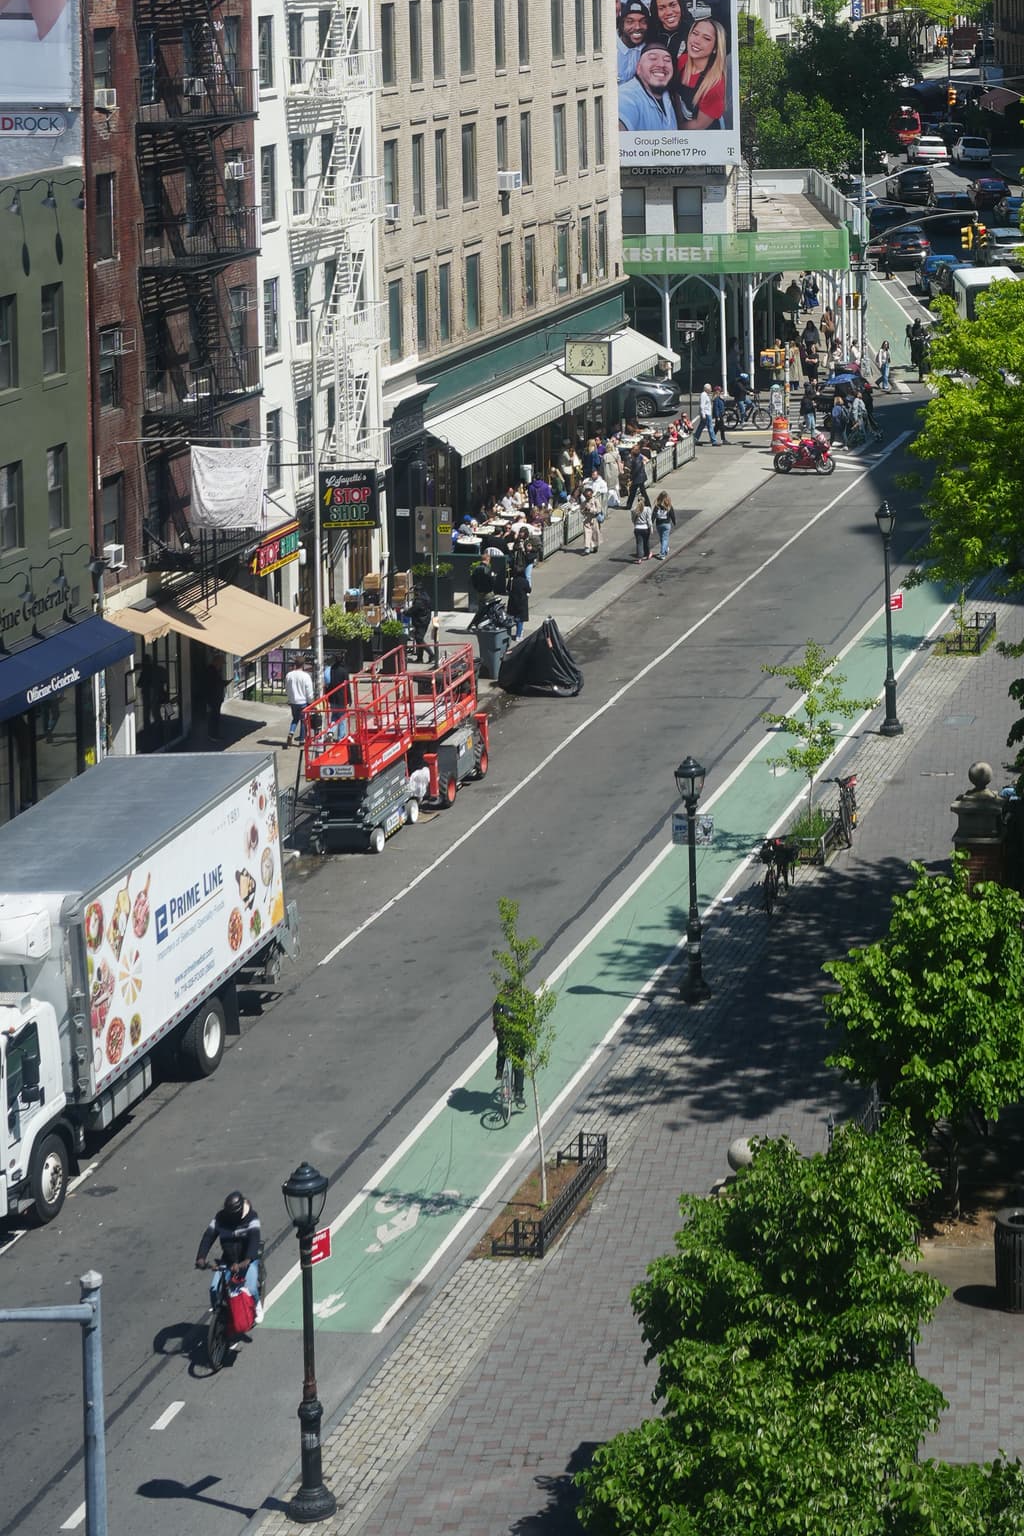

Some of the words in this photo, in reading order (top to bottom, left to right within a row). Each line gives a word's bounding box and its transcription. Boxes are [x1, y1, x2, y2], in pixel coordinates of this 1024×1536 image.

[634, 137, 660, 146] Group
[661, 136, 689, 145] Selfies
[651, 149, 681, 157] iPhone
[682, 148, 690, 156] 17
[692, 148, 707, 156] Pro
[641, 247, 713, 262] STREET
[323, 487, 333, 506] 1
[333, 487, 372, 505] STOP
[330, 504, 370, 522] SHOP
[257, 541, 280, 569] STOP
[26, 684, 53, 704] Officine
[51, 667, 81, 691] Générale
[169, 882, 201, 924] PRIME
[202, 863, 224, 897] LINE
